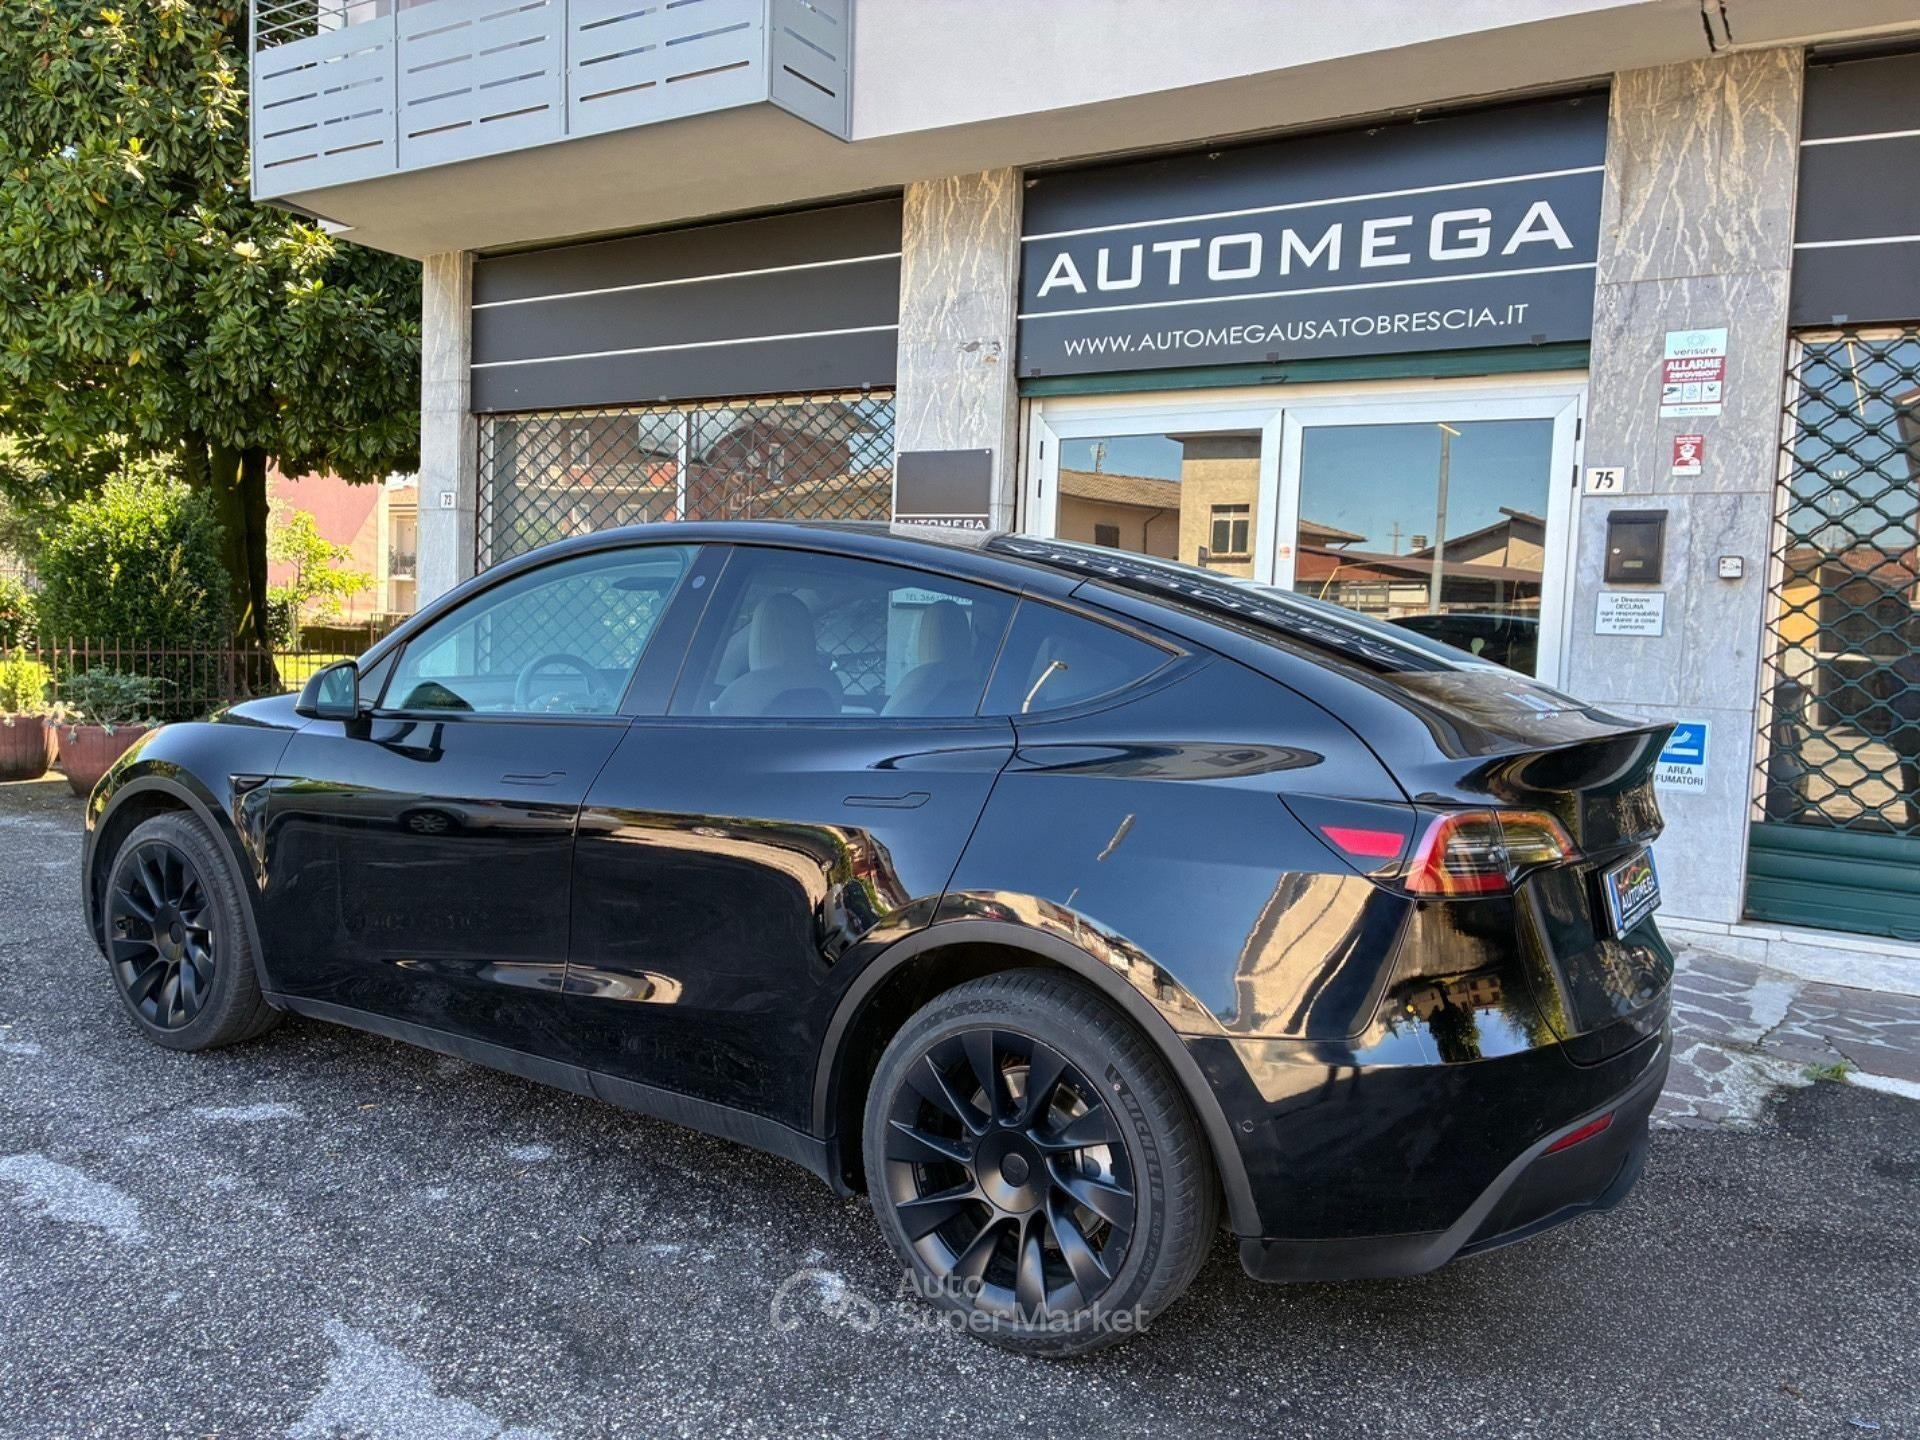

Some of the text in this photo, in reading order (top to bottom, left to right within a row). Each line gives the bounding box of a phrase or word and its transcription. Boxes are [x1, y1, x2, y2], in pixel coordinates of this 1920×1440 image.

[1037, 200, 1573, 297] AUTOMEGA
[1064, 303, 1529, 356] WWW.AUTOMEGAUSATOBRESCIA.IT
[1673, 347, 1717, 355] verisure
[1666, 359, 1722, 371] ALLARME
[1595, 471, 1614, 489] 75
[1667, 765, 1692, 775] AREA
[1655, 774, 1703, 786] FUMATORI
